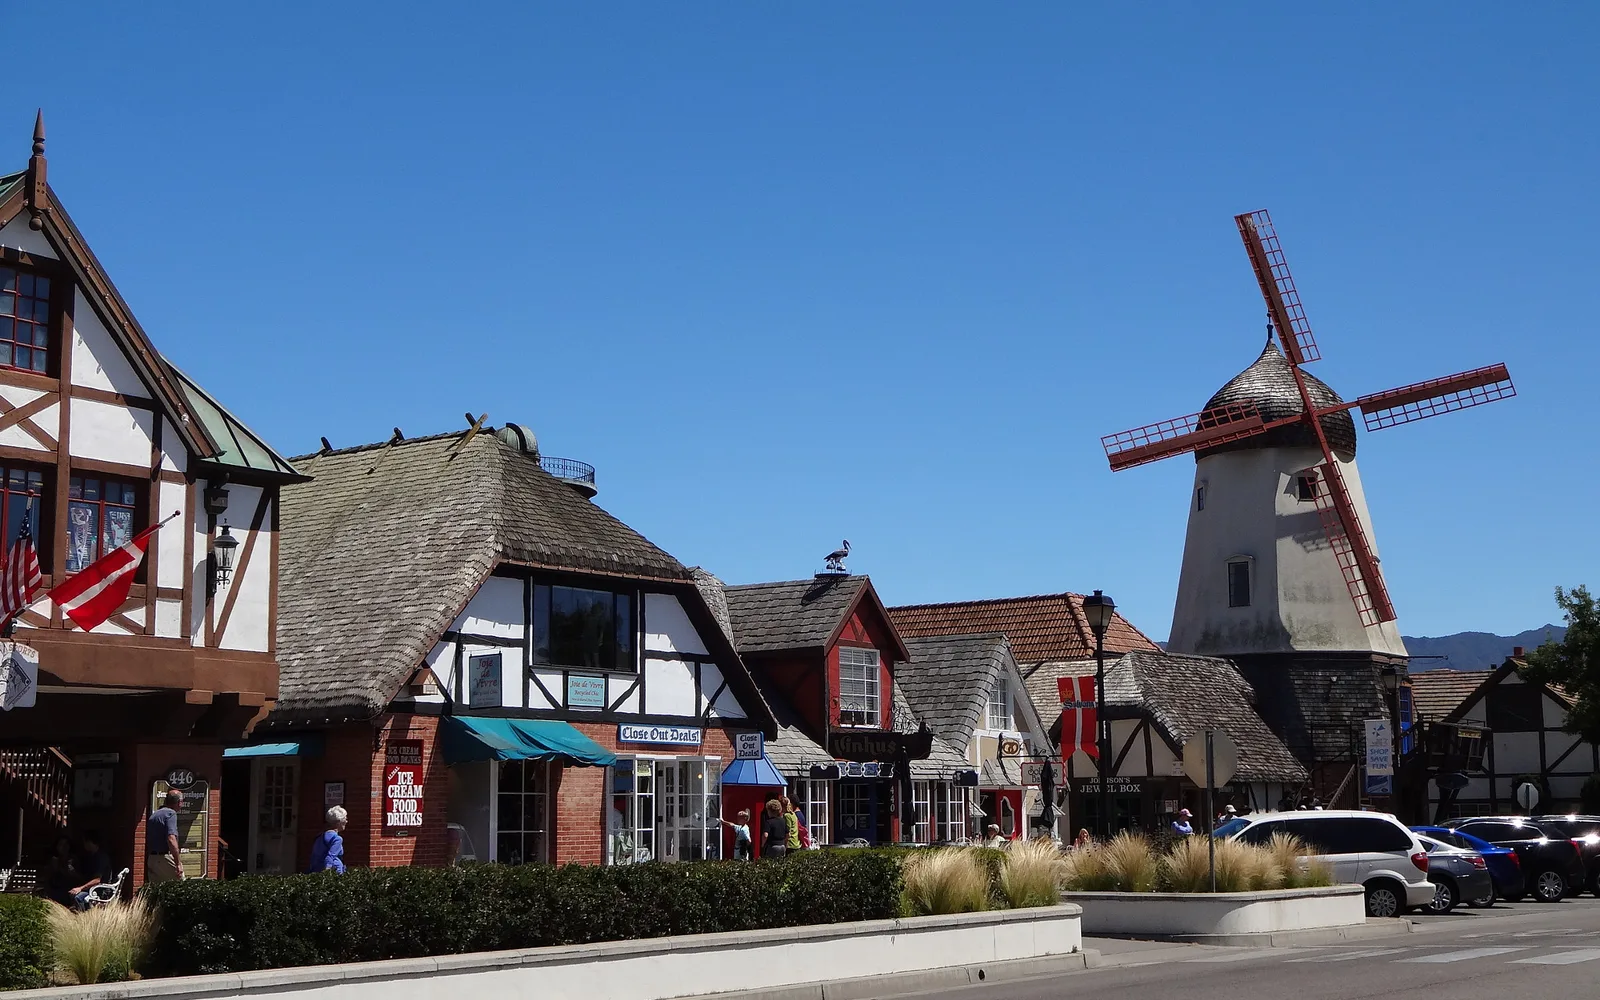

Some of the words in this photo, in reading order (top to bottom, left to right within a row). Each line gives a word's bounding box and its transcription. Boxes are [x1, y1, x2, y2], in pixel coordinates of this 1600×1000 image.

[622, 726, 648, 740] Close
[650, 727, 668, 741] Out
[670, 729, 700, 742] Deals!
[740, 734, 757, 742] Close
[388, 745, 397, 755] ICE
[399, 746, 420, 755] CREAM
[835, 735, 897, 755] Vinhus
[738, 749, 759, 757] Deals!
[170, 771, 193, 785] 446
[397, 771, 414, 785] ICE
[387, 784, 423, 798] CREAM
[1120, 784, 1141, 793] BOX
[392, 799, 417, 812] FOOD
[387, 812, 423, 826] DRINKS
